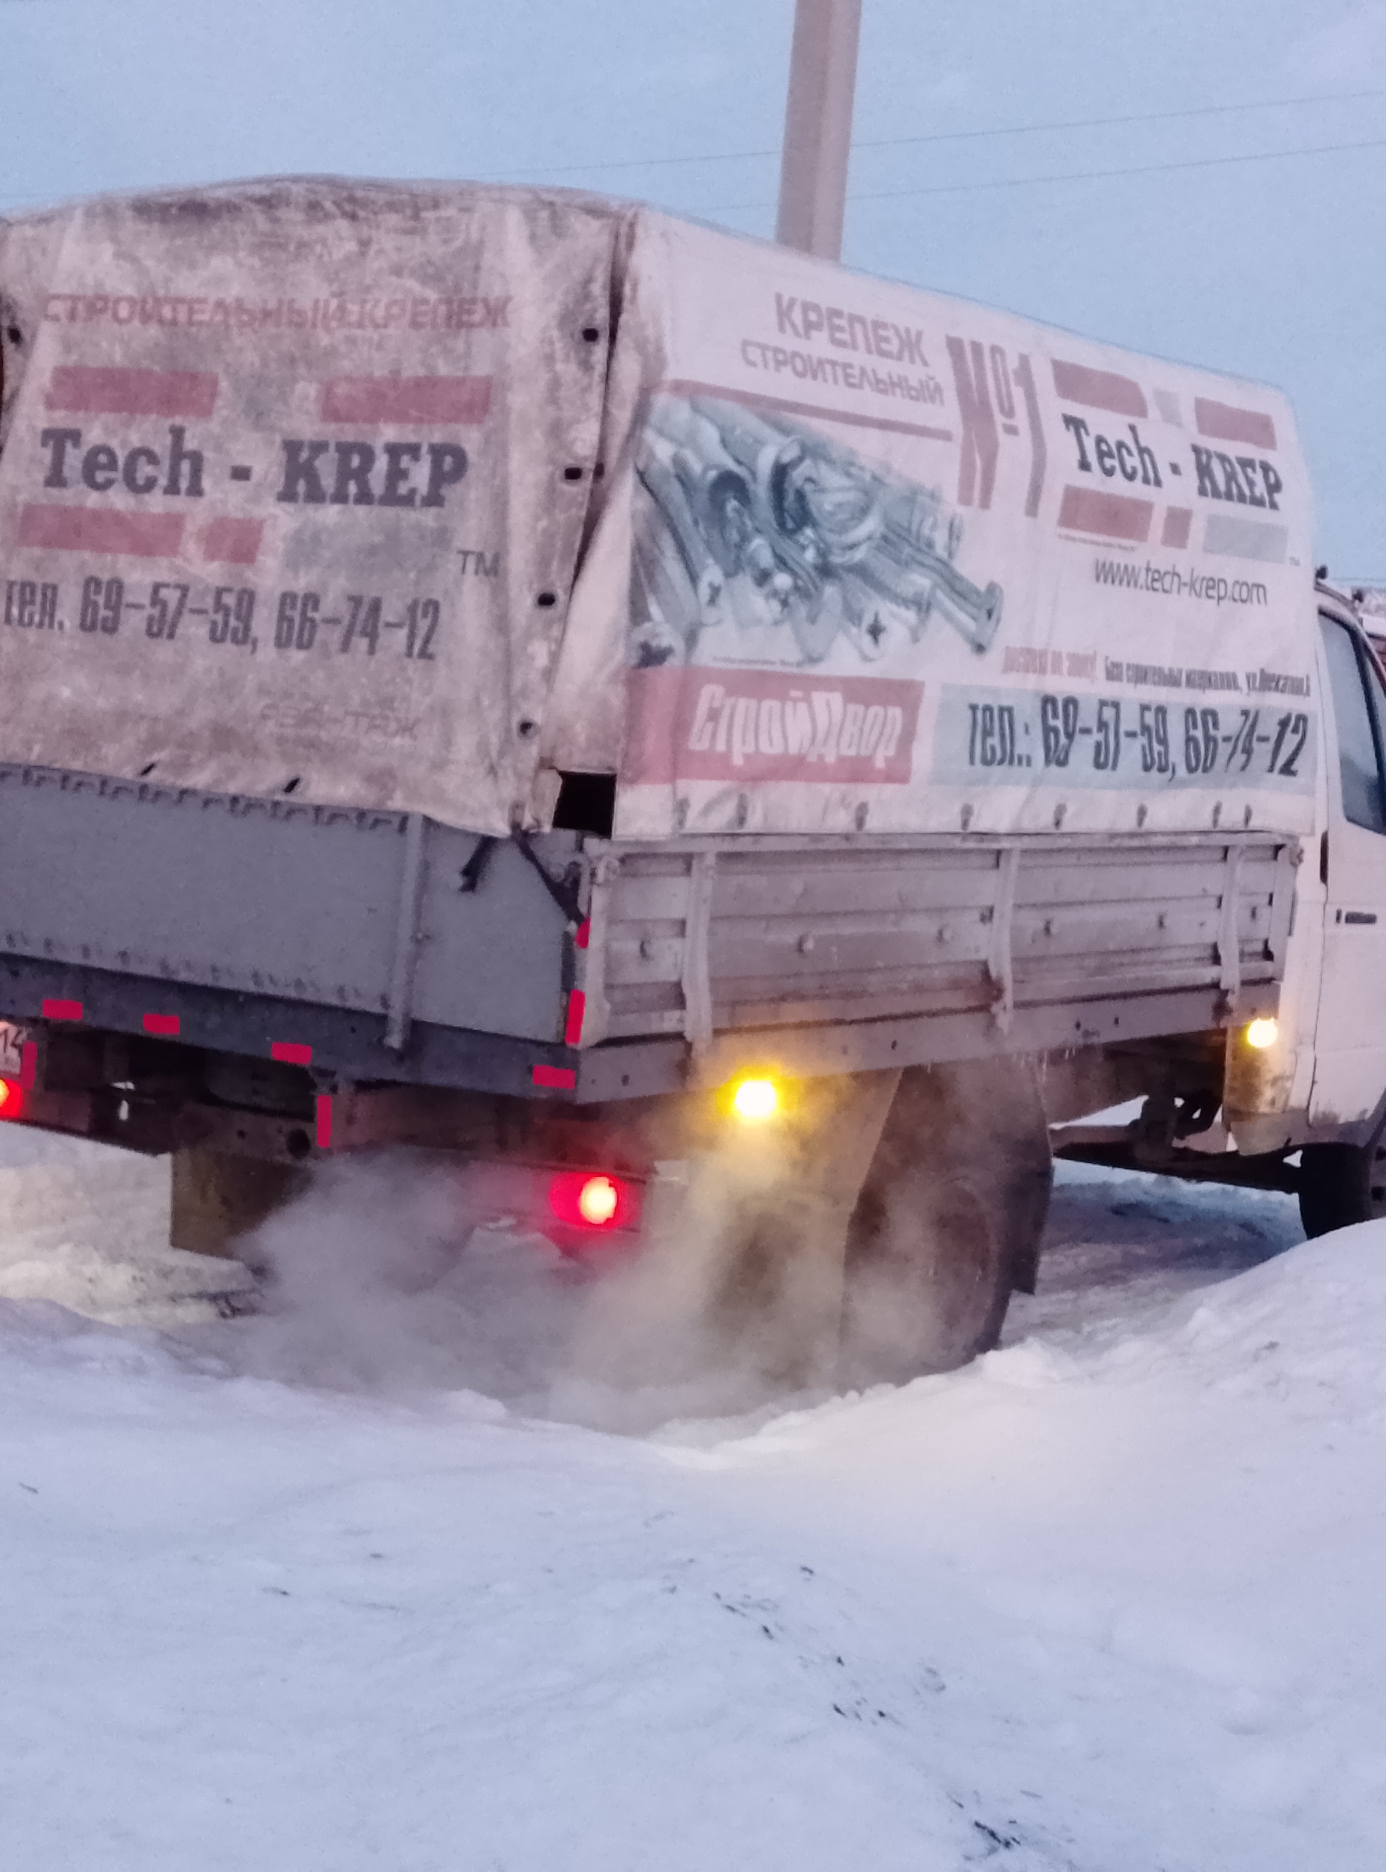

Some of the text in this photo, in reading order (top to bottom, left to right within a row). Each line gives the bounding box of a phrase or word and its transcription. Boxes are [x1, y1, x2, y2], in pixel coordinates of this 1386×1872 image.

[740, 338, 946, 406] СТРОИТЕЛЬНЫЙ
[40, 425, 205, 497] Tech
[277, 439, 469, 507] KREP
[1062, 413, 1163, 488] Tech
[1191, 443, 1282, 511] KREP
[3, 575, 441, 661] тел. 69-57-59, 66-74-12
[1094, 557, 1268, 606] www.tech-krep.com
[688, 683, 903, 769] СтройДвор
[1040, 694, 1176, 782] 69-57-59,
[1184, 707, 1309, 777] 66-74-12
